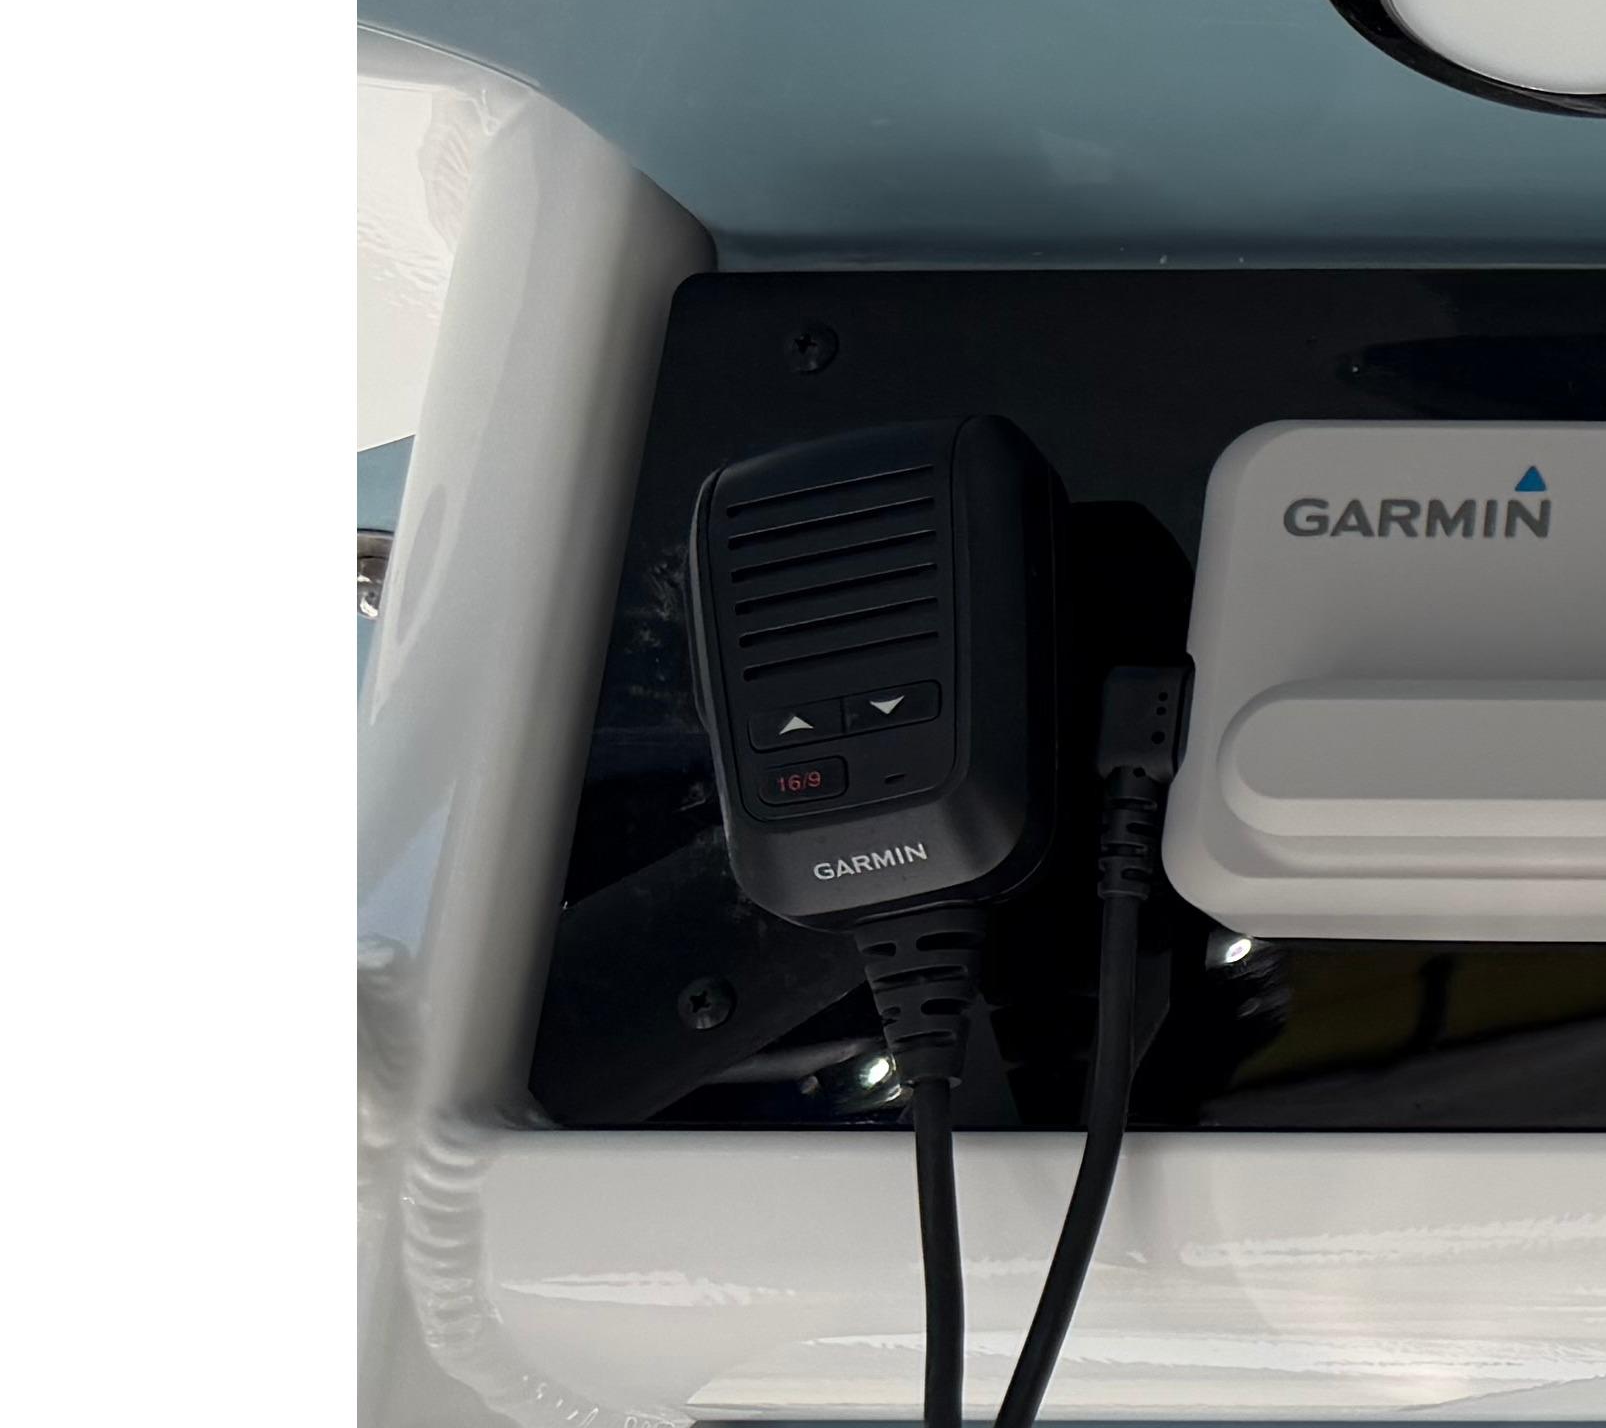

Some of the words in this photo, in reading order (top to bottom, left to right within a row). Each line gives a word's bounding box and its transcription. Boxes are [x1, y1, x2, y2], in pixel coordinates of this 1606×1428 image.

[1282, 496, 1553, 539] GARMIN
[776, 770, 823, 793] 16/9
[812, 841, 929, 881] GARMIN
